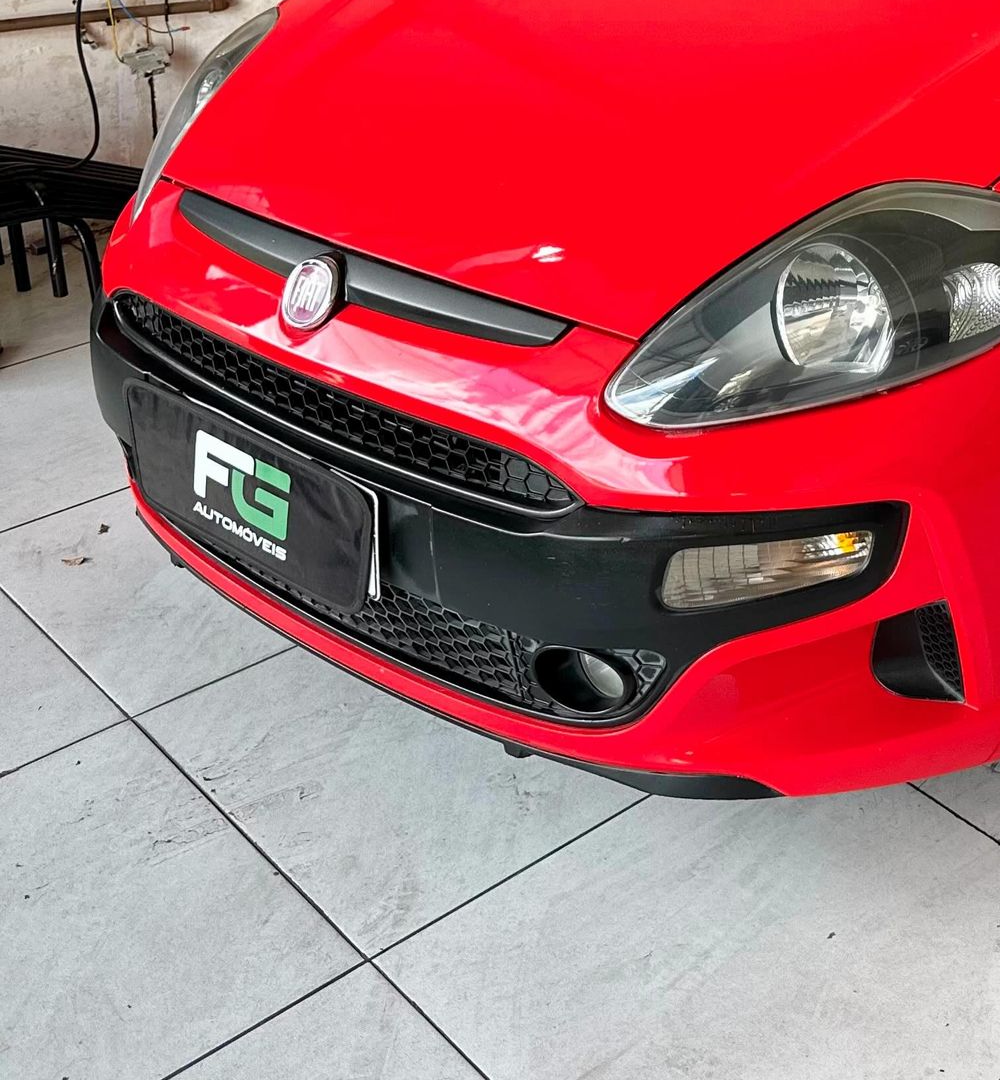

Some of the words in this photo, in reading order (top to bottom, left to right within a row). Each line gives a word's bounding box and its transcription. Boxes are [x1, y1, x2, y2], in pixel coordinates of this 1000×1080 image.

[291, 275, 324, 312] FIAT
[193, 429, 291, 541] FG
[193, 501, 287, 561] AUTOMÓVEIS
